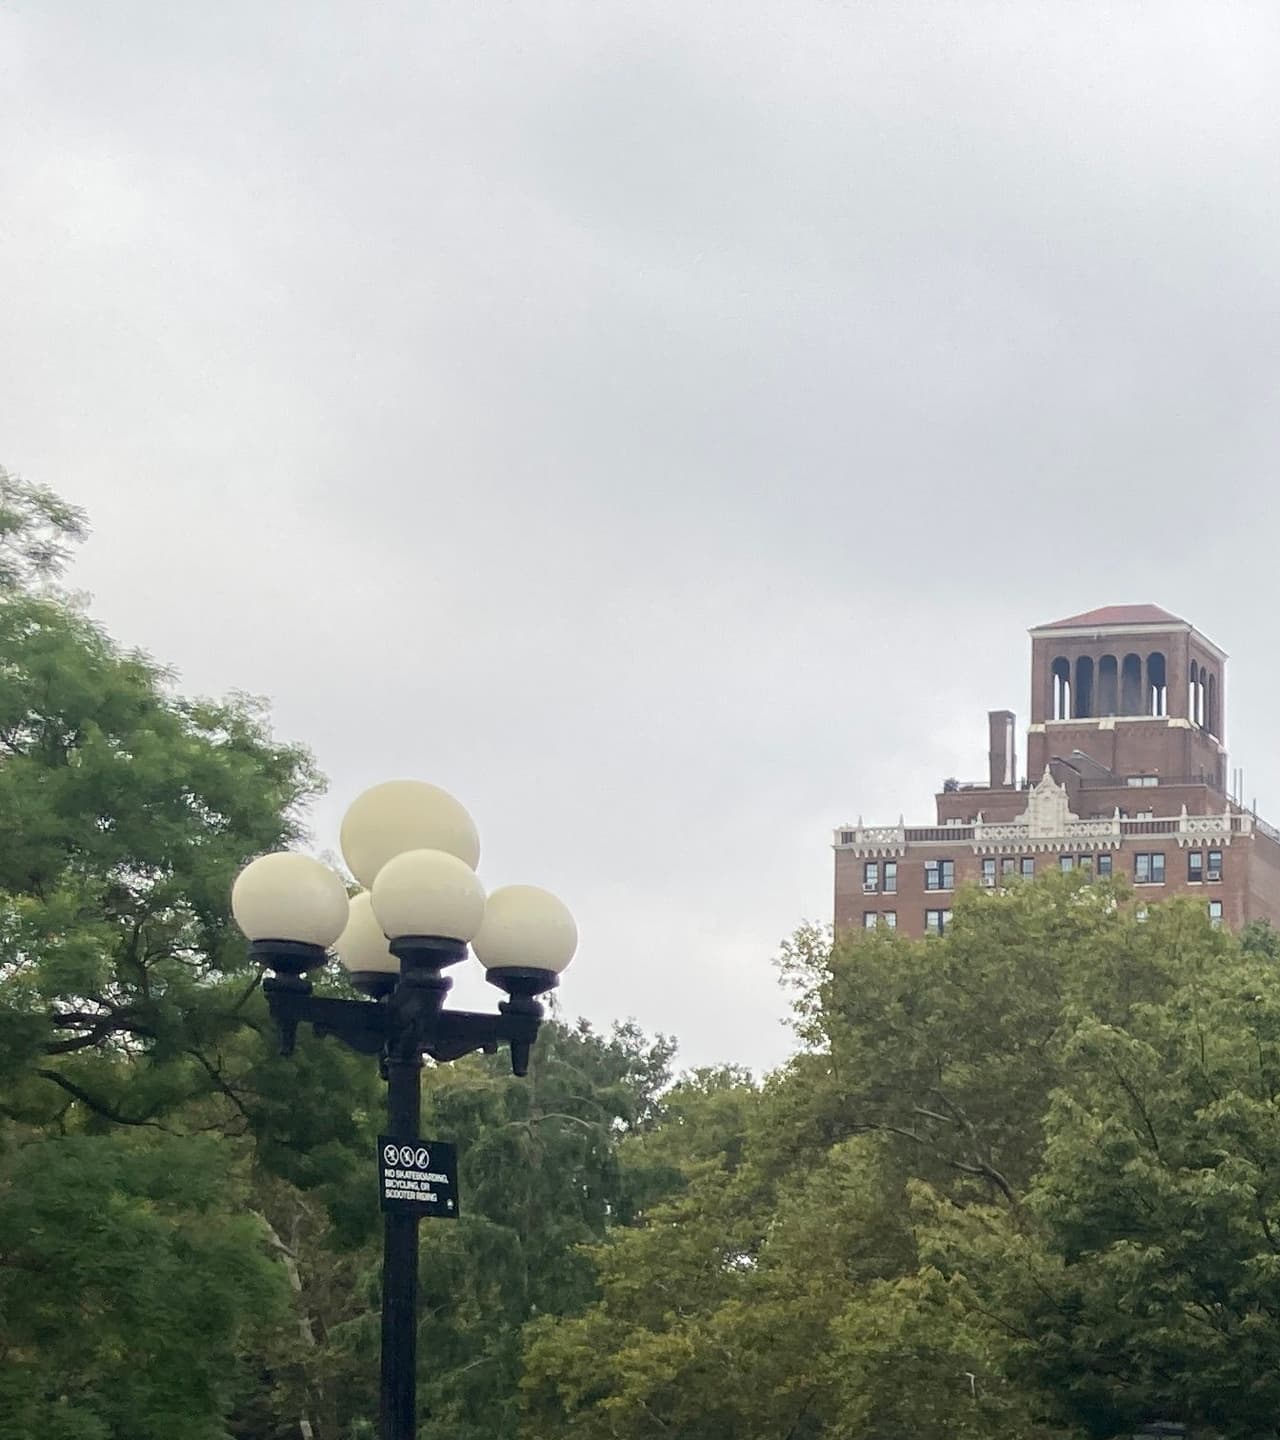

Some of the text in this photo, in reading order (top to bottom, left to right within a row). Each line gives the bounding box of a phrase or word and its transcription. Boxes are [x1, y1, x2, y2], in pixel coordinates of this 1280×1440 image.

[385, 1168, 449, 1184] NO SKATEBOARDING,
[385, 1178, 430, 1191] BICYCLING, OR
[385, 1189, 415, 1200] SCOOTER
